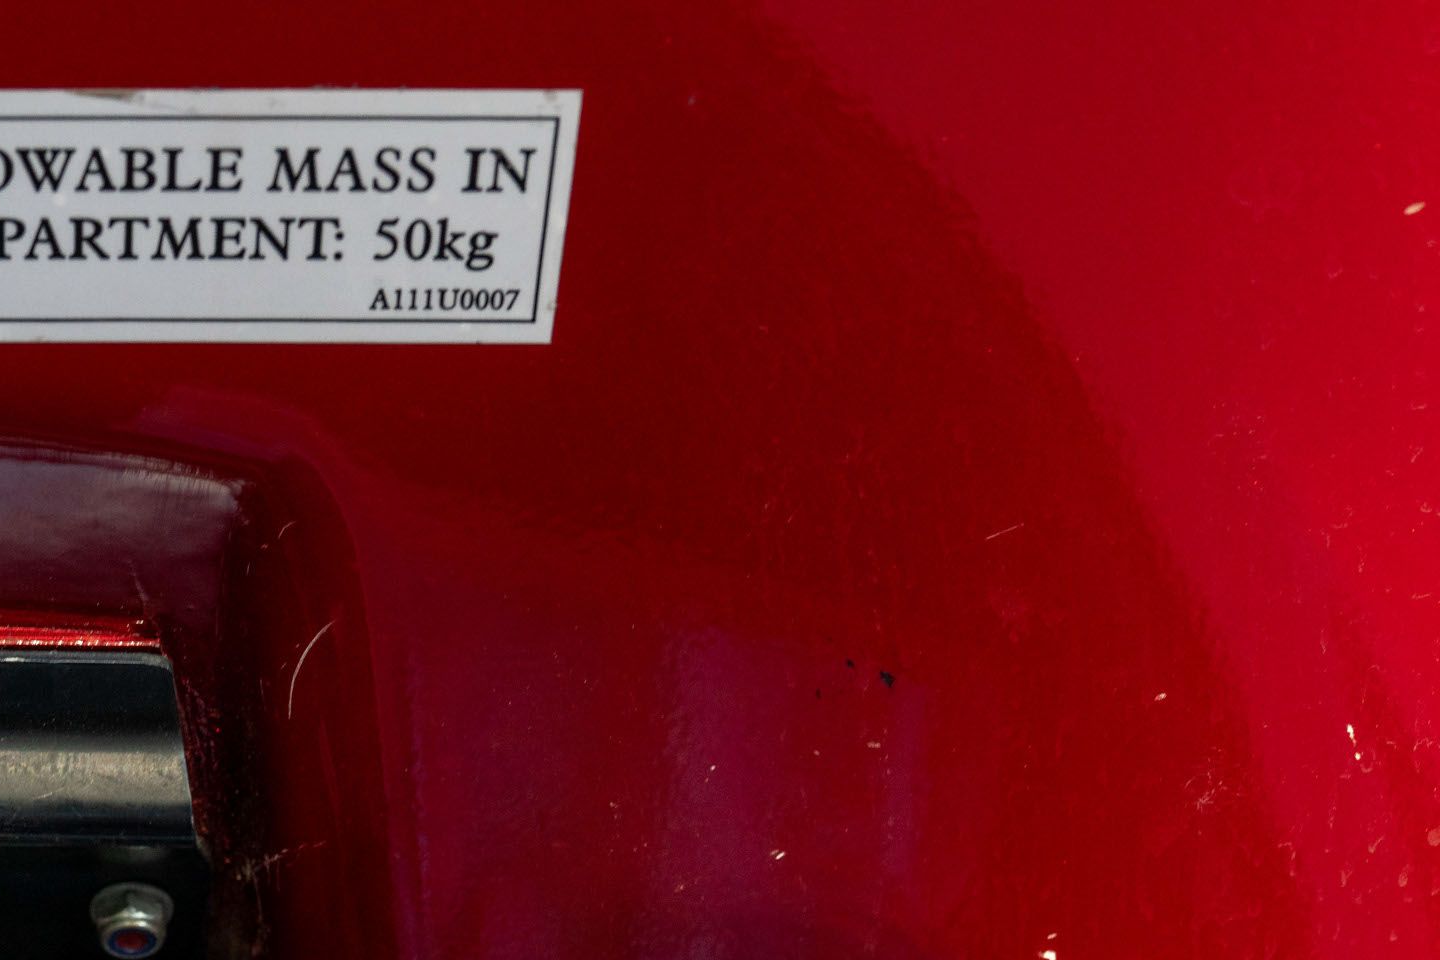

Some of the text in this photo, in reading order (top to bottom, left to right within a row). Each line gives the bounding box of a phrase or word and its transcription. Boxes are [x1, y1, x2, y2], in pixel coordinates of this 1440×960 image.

[266, 147, 437, 194] MASS
[461, 148, 538, 194] IN
[373, 216, 499, 272] 50kg
[368, 287, 522, 312] A111U0007
